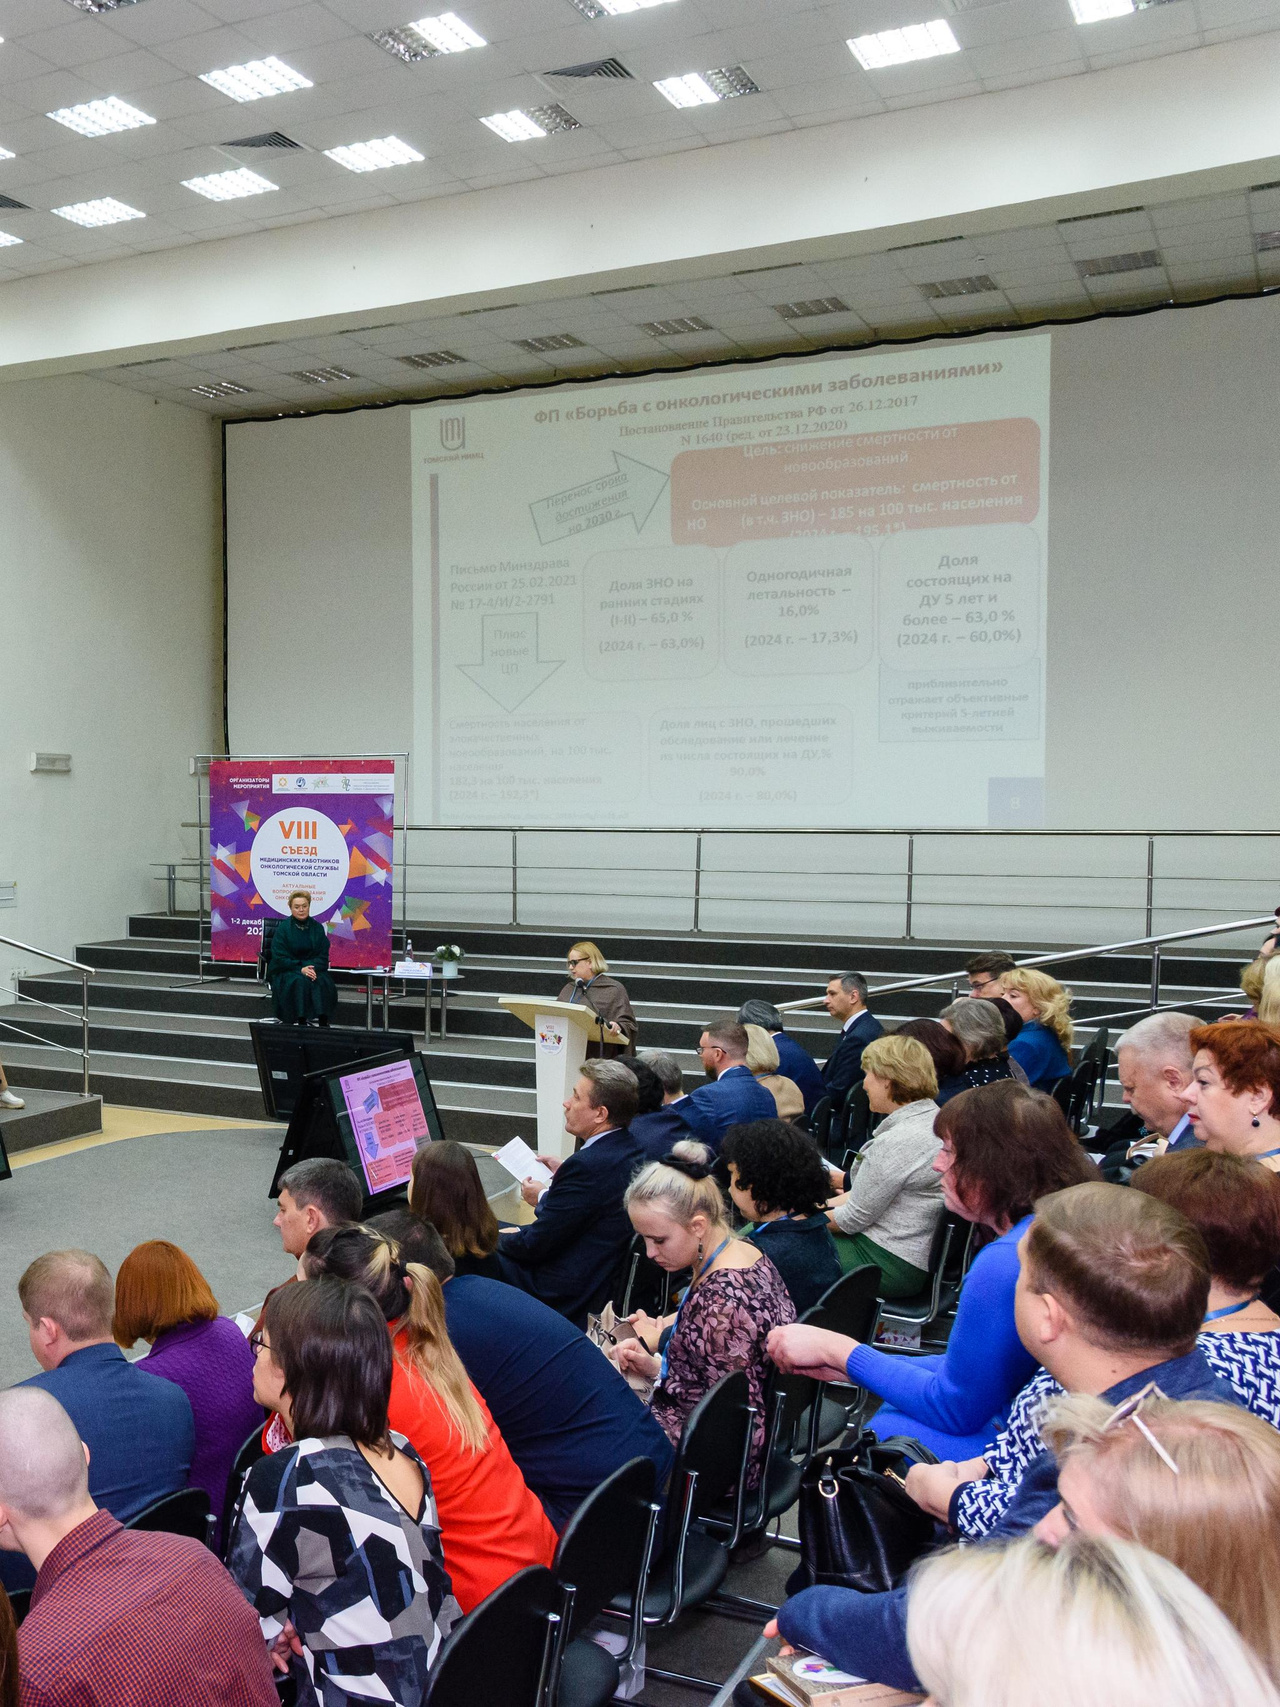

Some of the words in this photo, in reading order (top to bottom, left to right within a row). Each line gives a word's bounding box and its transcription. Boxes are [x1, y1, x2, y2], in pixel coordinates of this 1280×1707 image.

[534, 410, 560, 425] ФП
[565, 402, 637, 423] «Борьба
[643, 403, 652, 412] с
[656, 381, 822, 412] онкологическими
[828, 361, 1004, 393] заболеваниями»
[619, 417, 709, 437] Постановление
[713, 408, 803, 427] Правительства
[808, 406, 827, 417] РФ
[830, 406, 845, 415] от
[849, 396, 919, 413] 26.12.2017
[681, 435, 691, 446] N
[695, 431, 723, 444] 1640
[726, 430, 754, 444] (ред.
[759, 428, 772, 438] от
[776, 421, 848, 436] 23.12.2020)
[743, 445, 782, 460] Цель:
[784, 439, 853, 455] снижение
[856, 429, 938, 448] смертности
[941, 428, 958, 438] от
[784, 453, 909, 473] новообразований
[545, 487, 593, 509] Перенос
[596, 472, 628, 492] срока
[692, 492, 758, 511] Основной
[761, 488, 818, 507] целевой
[821, 484, 906, 501] показатель:
[912, 475, 998, 493] смертность
[1000, 474, 1018, 485] от
[555, 490, 629, 523] достижения
[687, 519, 706, 530] НО
[782, 510, 816, 526] ЗНО)
[830, 506, 854, 519] 185
[858, 507, 875, 517] на
[880, 502, 904, 516] 100
[908, 502, 938, 514] тыс.
[942, 494, 1023, 511] населения
[450, 564, 496, 576] Письмо
[500, 559, 570, 574] Минздрава
[938, 555, 978, 569] Доля
[747, 566, 852, 584] Одногодичная
[906, 575, 989, 590] состоящих
[993, 572, 1012, 583] на
[450, 582, 492, 593] России
[495, 581, 507, 590] от
[511, 575, 577, 589] 25.02.2021
[609, 581, 642, 593] Доля
[646, 578, 674, 589] ЗНО
[679, 578, 693, 587] на
[450, 600, 465, 610] №
[468, 592, 555, 610] 17-4/И/2-2791
[600, 598, 647, 610] ранних
[650, 594, 704, 607] стадиях
[747, 586, 836, 601] летальность
[919, 594, 940, 609] ДУ
[945, 594, 954, 605] 5
[958, 594, 983, 605] лет
[988, 593, 997, 603] и
[778, 605, 820, 618] 16,0%
[902, 613, 948, 626] более
[965, 611, 998, 625] 63,0
[1001, 610, 1015, 622] %
[493, 630, 528, 640] Плюс
[744, 634, 782, 648] (2024
[811, 630, 859, 645] 17,3%)
[897, 633, 938, 648] (2024
[969, 628, 1022, 644] 60,0%)
[490, 647, 529, 657] новые
[599, 640, 634, 654] (2024
[660, 637, 705, 651] 63,0%)
[502, 664, 519, 676] ЦП
[908, 678, 1008, 690] приблизительно
[888, 695, 943, 706] отражает
[946, 692, 1029, 704] объективные
[912, 724, 1003, 733] выживаемости
[279, 821, 318, 839] VIII
[281, 846, 318, 857] СЪЕЗД
[247, 927, 262, 935] 202
